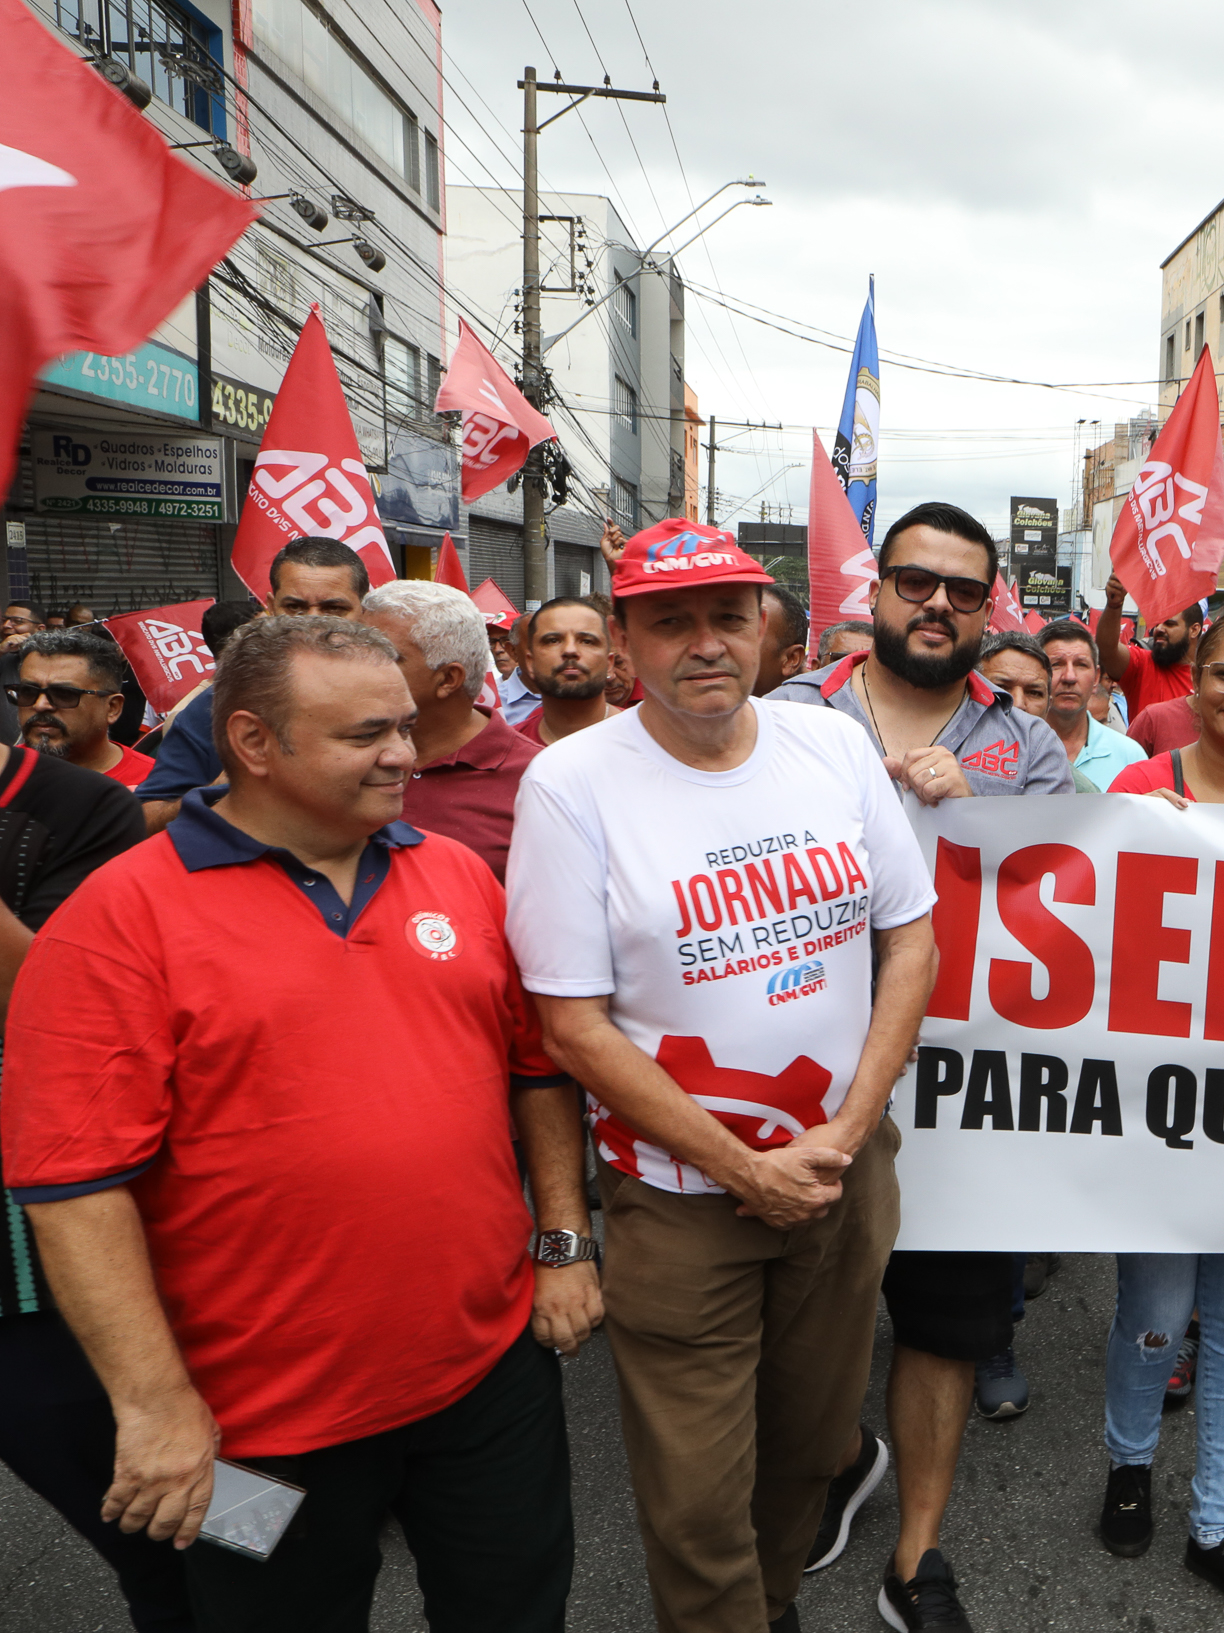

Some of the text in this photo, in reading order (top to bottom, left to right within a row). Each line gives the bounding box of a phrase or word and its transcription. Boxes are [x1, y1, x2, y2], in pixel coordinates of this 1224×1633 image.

[212, 381, 273, 431] 4335-9
[37, 457, 72, 467] Realce
[52, 435, 92, 467] RD
[100, 440, 218, 460] Quadros Espelhos
[56, 467, 87, 476] Decor
[106, 456, 213, 475] Vidros Molduras
[95, 480, 217, 496] www.realcedecor.com.br
[86, 499, 149, 514] 4335-9948
[158, 502, 219, 517] 4972-3251
[1014, 517, 1053, 527] Colchões
[144, 619, 205, 680] ABC
[961, 750, 1019, 776] ABC
[705, 830, 818, 868] REDUZIR A
[671, 841, 868, 939] JORNADA
[678, 895, 869, 967] SEM REDUZIR
[430, 951, 456, 961] ABC
[682, 951, 783, 986] SALÁRIOS
[787, 945, 800, 962] E
[803, 917, 867, 957] DIREITOS
[914, 1046, 1123, 1137] PARA
